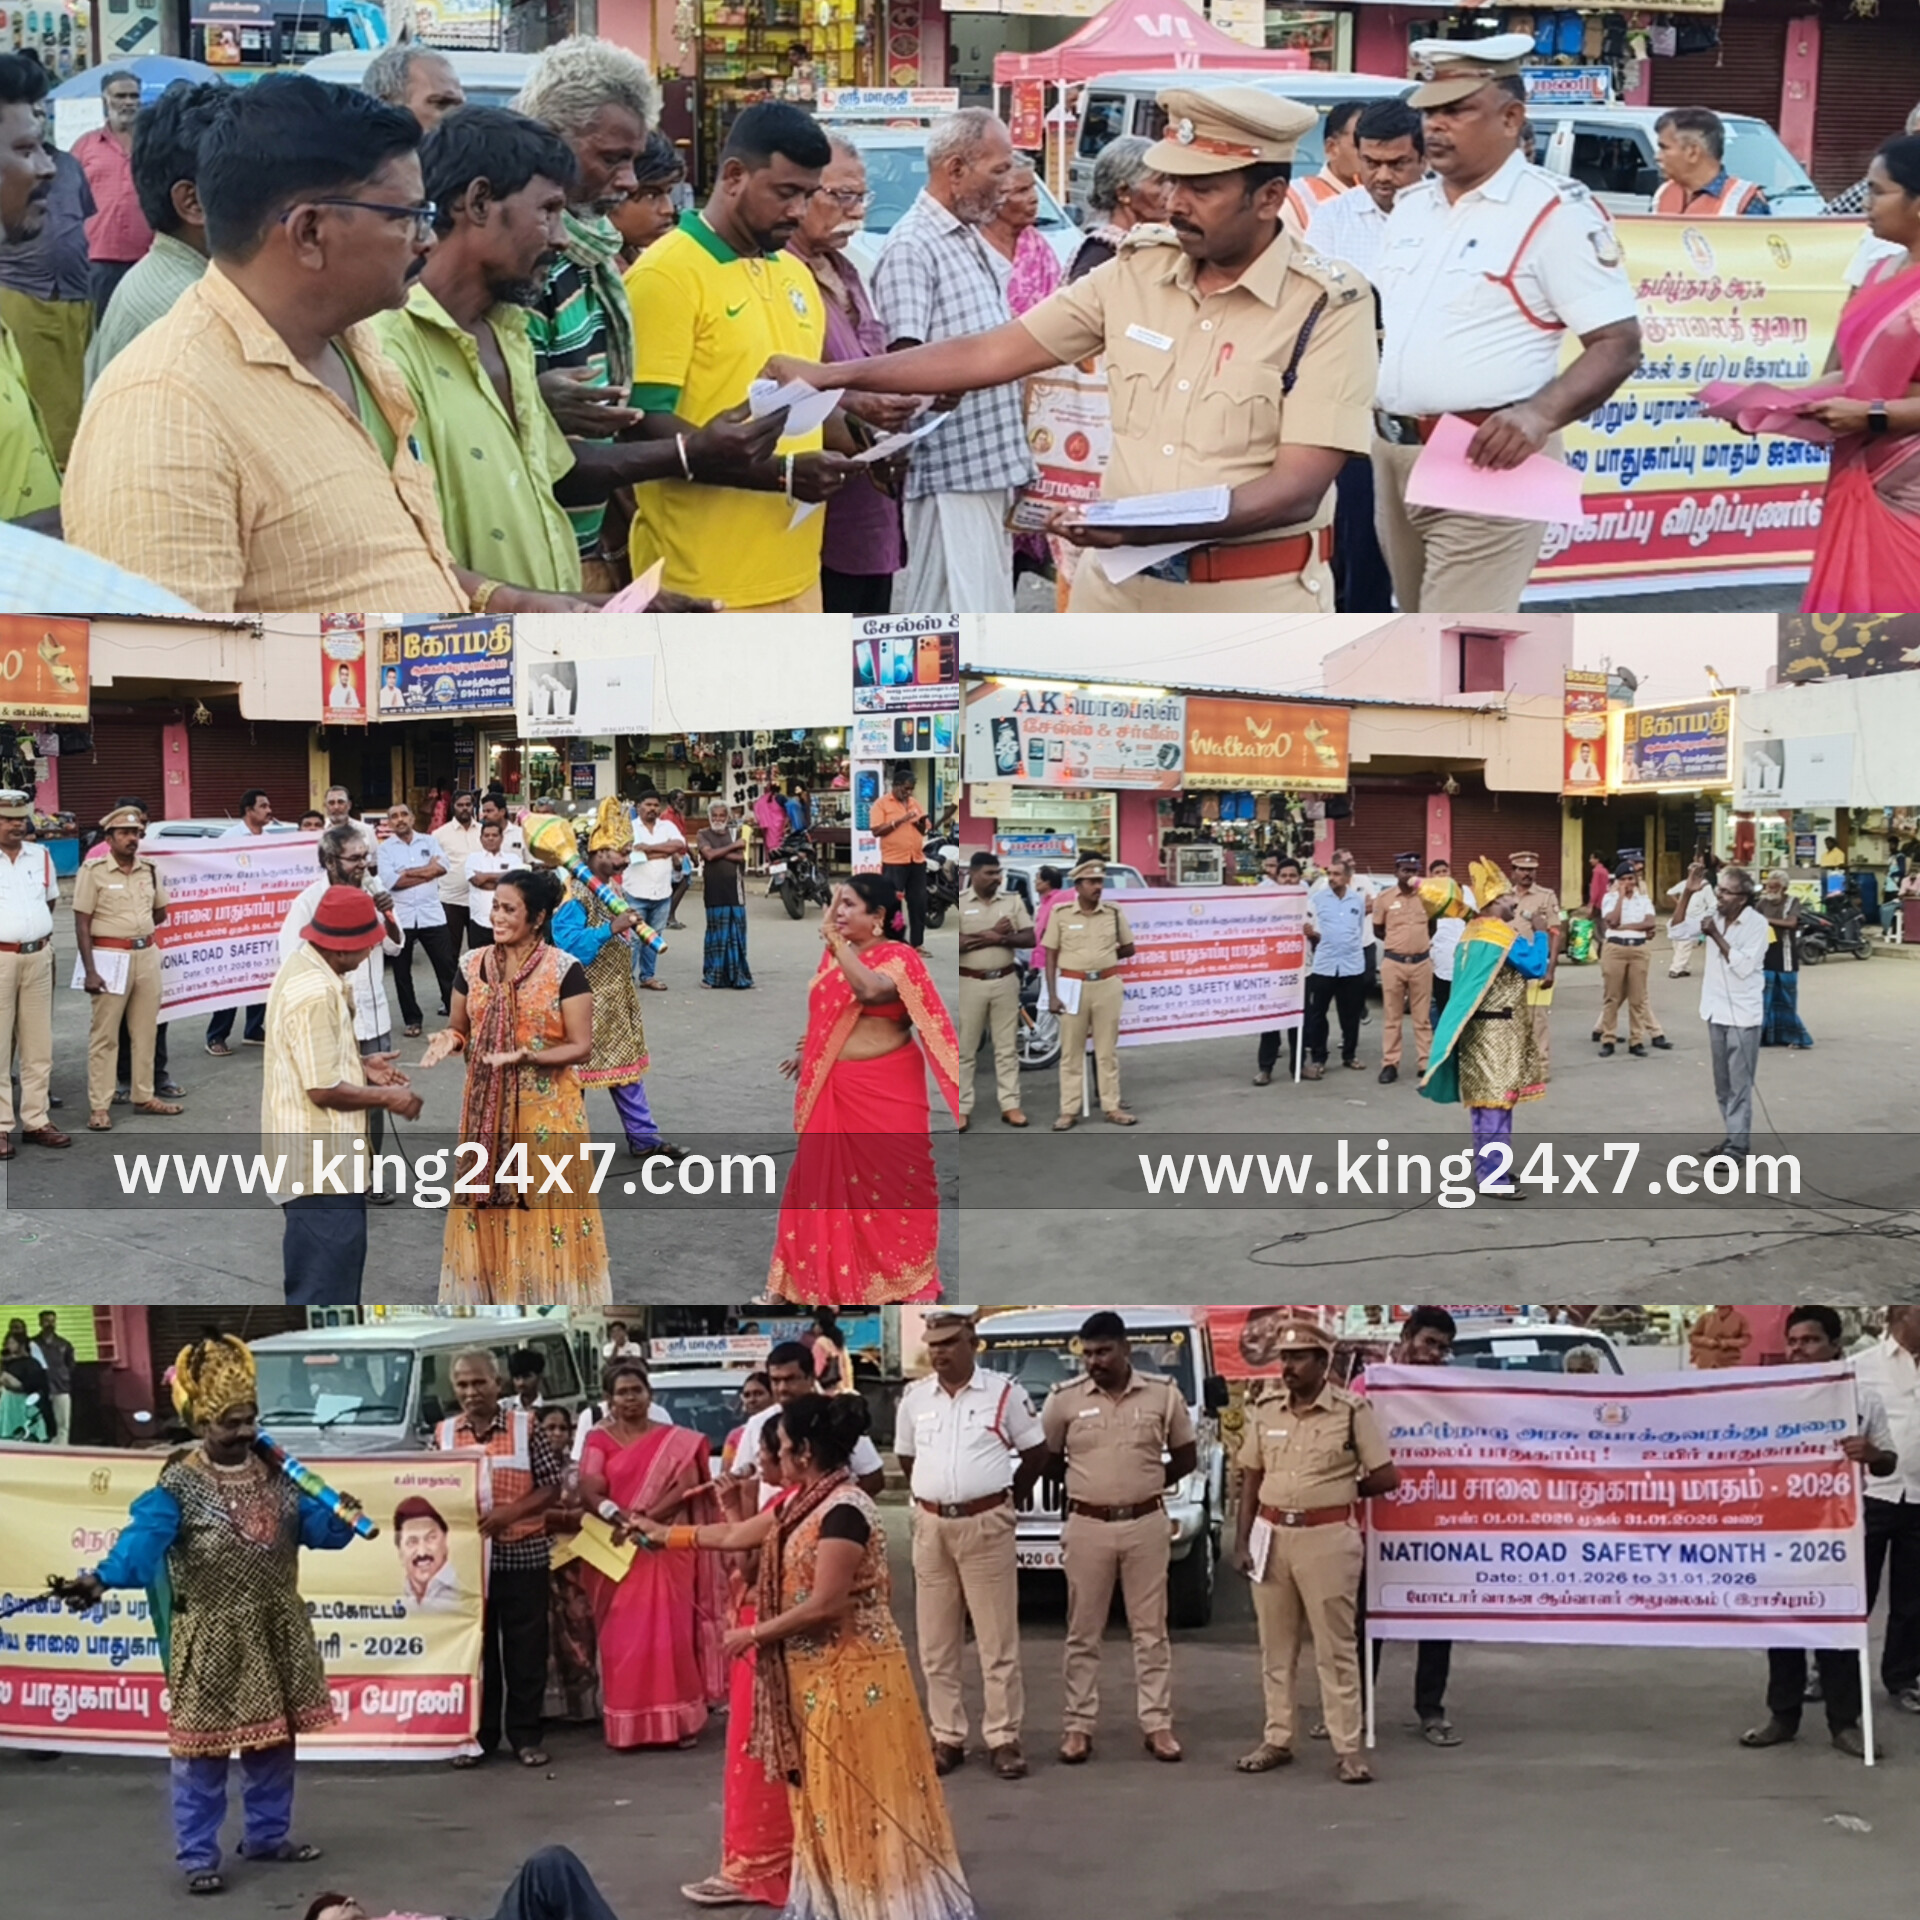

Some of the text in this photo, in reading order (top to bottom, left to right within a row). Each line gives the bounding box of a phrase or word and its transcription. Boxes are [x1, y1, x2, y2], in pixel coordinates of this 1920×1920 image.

[1750, 316, 1808, 346] துறை
[1595, 437, 1696, 485] பாதுகாப்பு
[1702, 435, 1760, 475] மாதம்
[1538, 499, 1655, 560] துகாப்பு
[863, 615, 942, 635] சேல்ஸ்
[403, 623, 512, 659] கோமதி
[1013, 690, 1062, 715] AK
[1640, 706, 1730, 738] கோமதி
[181, 882, 240, 898] பாதுகாப்பு
[174, 911, 213, 926] சாலை
[215, 895, 276, 923] பாதுகாப்பு
[192, 948, 224, 963] ROAD
[230, 940, 273, 958] SAFETY
[1131, 951, 1168, 965] சாலை
[1170, 941, 1230, 965] பாதுகாப்பு
[1231, 938, 1268, 960] மாதம்
[205, 961, 252, 975] 01.01.2026
[254, 959, 263, 968] to
[1151, 985, 1183, 999] ROAD
[1189, 981, 1231, 995] SAFETY
[1234, 978, 1271, 991] MONTH
[1389, 1418, 1847, 1443] தமிழ்நாடு அரசு போக்குவரத்து துறை
[1479, 1445, 1597, 1463] பாதுகாப்பு
[1641, 1446, 1699, 1461] உயிர்
[1706, 1441, 1827, 1462] பாதுகாப்பு
[1463, 1477, 1541, 1500] சாலை
[1546, 1470, 1676, 1508] பாதுகாப்பு
[1681, 1467, 1764, 1507] மாதம்
[1786, 1472, 1851, 1499] 2026
[1482, 1512, 1575, 1526] 01.01.2026
[1576, 1511, 1621, 1528] முதல்
[1624, 1512, 1719, 1527] 31.01.2026
[1721, 1513, 1764, 1526] வரை
[1379, 1541, 1494, 1563] NATIONAL
[1500, 1541, 1568, 1563] ROAD
[1581, 1541, 1674, 1563] SAFETY
[1680, 1541, 1766, 1563] MONTH
[1789, 1540, 1847, 1563] 2026
[1476, 1572, 1757, 1585] Date: 01.01.2026 to 31.01.2026
[1406, 1588, 1477, 1605] மோட்டார்
[1481, 1594, 1534, 1605] வாகன
[1536, 1590, 1621, 1607] ஆய்வாளர்
[1625, 1590, 1718, 1610] அலுவலகம்
[26, 1633, 159, 1667] சாலை பாதுகா
[363, 1636, 424, 1656] 2026
[21, 1677, 150, 1721] பாதுகாப்பு
[360, 1682, 465, 1721] பேரணி
